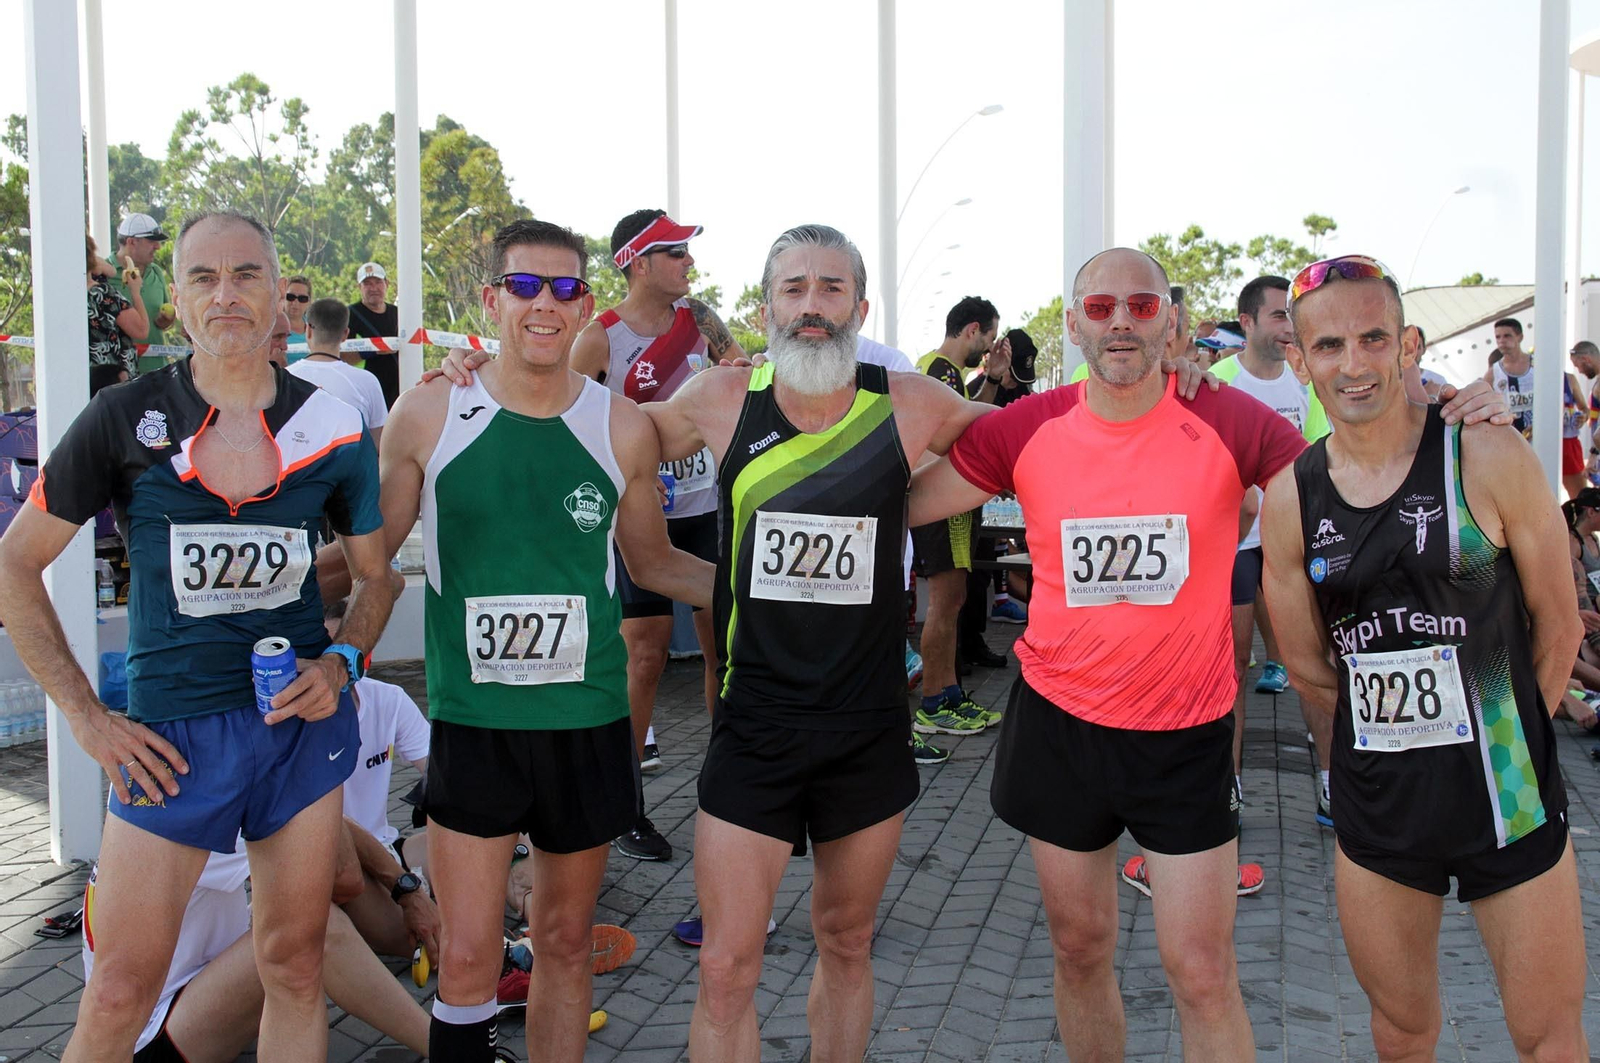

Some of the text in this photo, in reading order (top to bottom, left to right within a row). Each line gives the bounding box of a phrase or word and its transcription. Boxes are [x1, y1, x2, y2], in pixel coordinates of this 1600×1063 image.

[748, 431, 780, 455] Joma
[790, 519, 817, 527] GENERAL
[175, 530, 209, 539] DIRECCIÓN
[762, 528, 856, 581] 3226
[1072, 533, 1168, 583] 3225
[183, 541, 289, 592] 3229
[1309, 561, 1326, 579] PAZ
[756, 577, 812, 590] AGRUPACIÓN
[813, 580, 860, 592] DEPORTIVA
[1070, 582, 1176, 595] AGRUPACIÓN DEPORTIVA
[181, 582, 288, 603] AGRUPACIÓN DEPORTIVA
[800, 592, 814, 600] 3226
[230, 603, 246, 612] 3229
[476, 613, 568, 660] 3227
[1332, 607, 1467, 656] Skypi Team
[527, 661, 573, 672] DEPORTIVA
[1406, 655, 1432, 664] POLICÍA
[514, 674, 529, 682] 3227
[1354, 668, 1442, 724] 3228
[1359, 721, 1454, 737] AGRUPACIÓN DEPORTIVA
[1387, 739, 1402, 748] 3228
